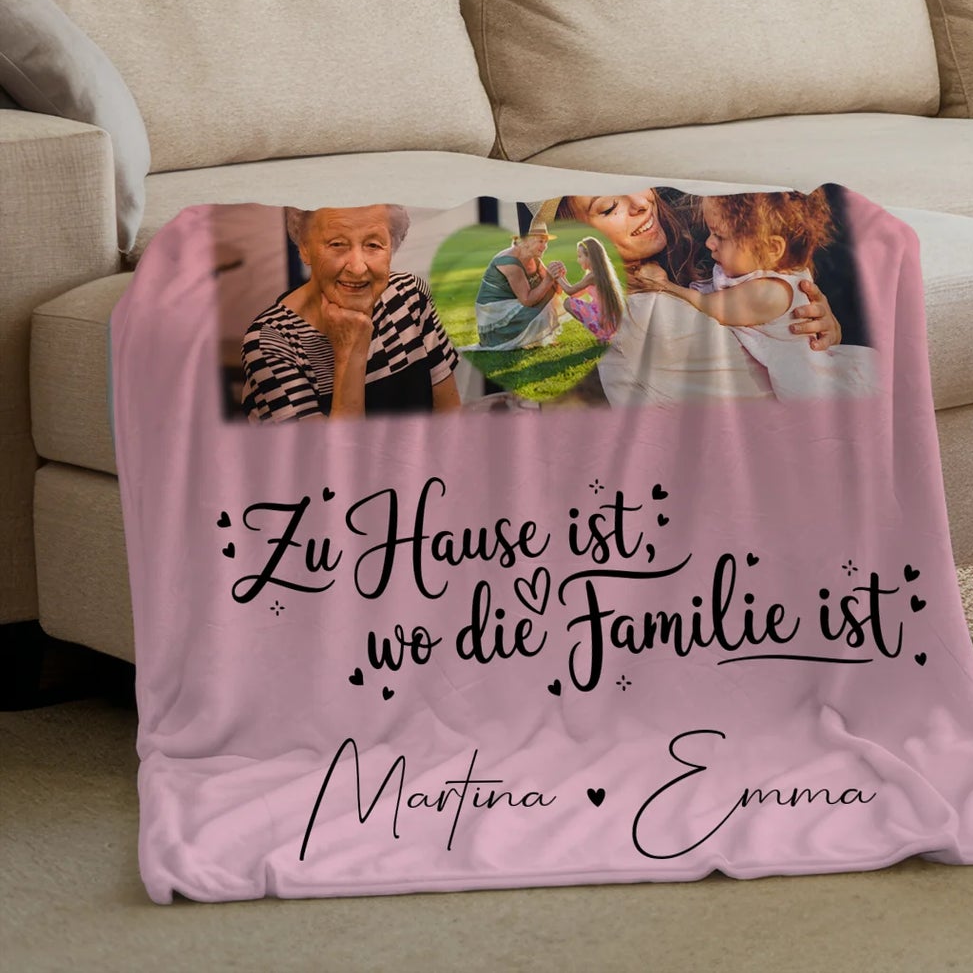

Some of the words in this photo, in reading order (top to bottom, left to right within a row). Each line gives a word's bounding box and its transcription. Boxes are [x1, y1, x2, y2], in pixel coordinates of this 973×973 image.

[231, 495, 343, 604] Zu
[345, 477, 551, 600] Hause
[568, 490, 656, 565] ist,
[367, 624, 443, 672] wo
[455, 580, 548, 664] die
[557, 553, 801, 692] Familie
[818, 572, 904, 659] ist
[299, 737, 557, 861] Martina
[632, 729, 877, 860] Emma
